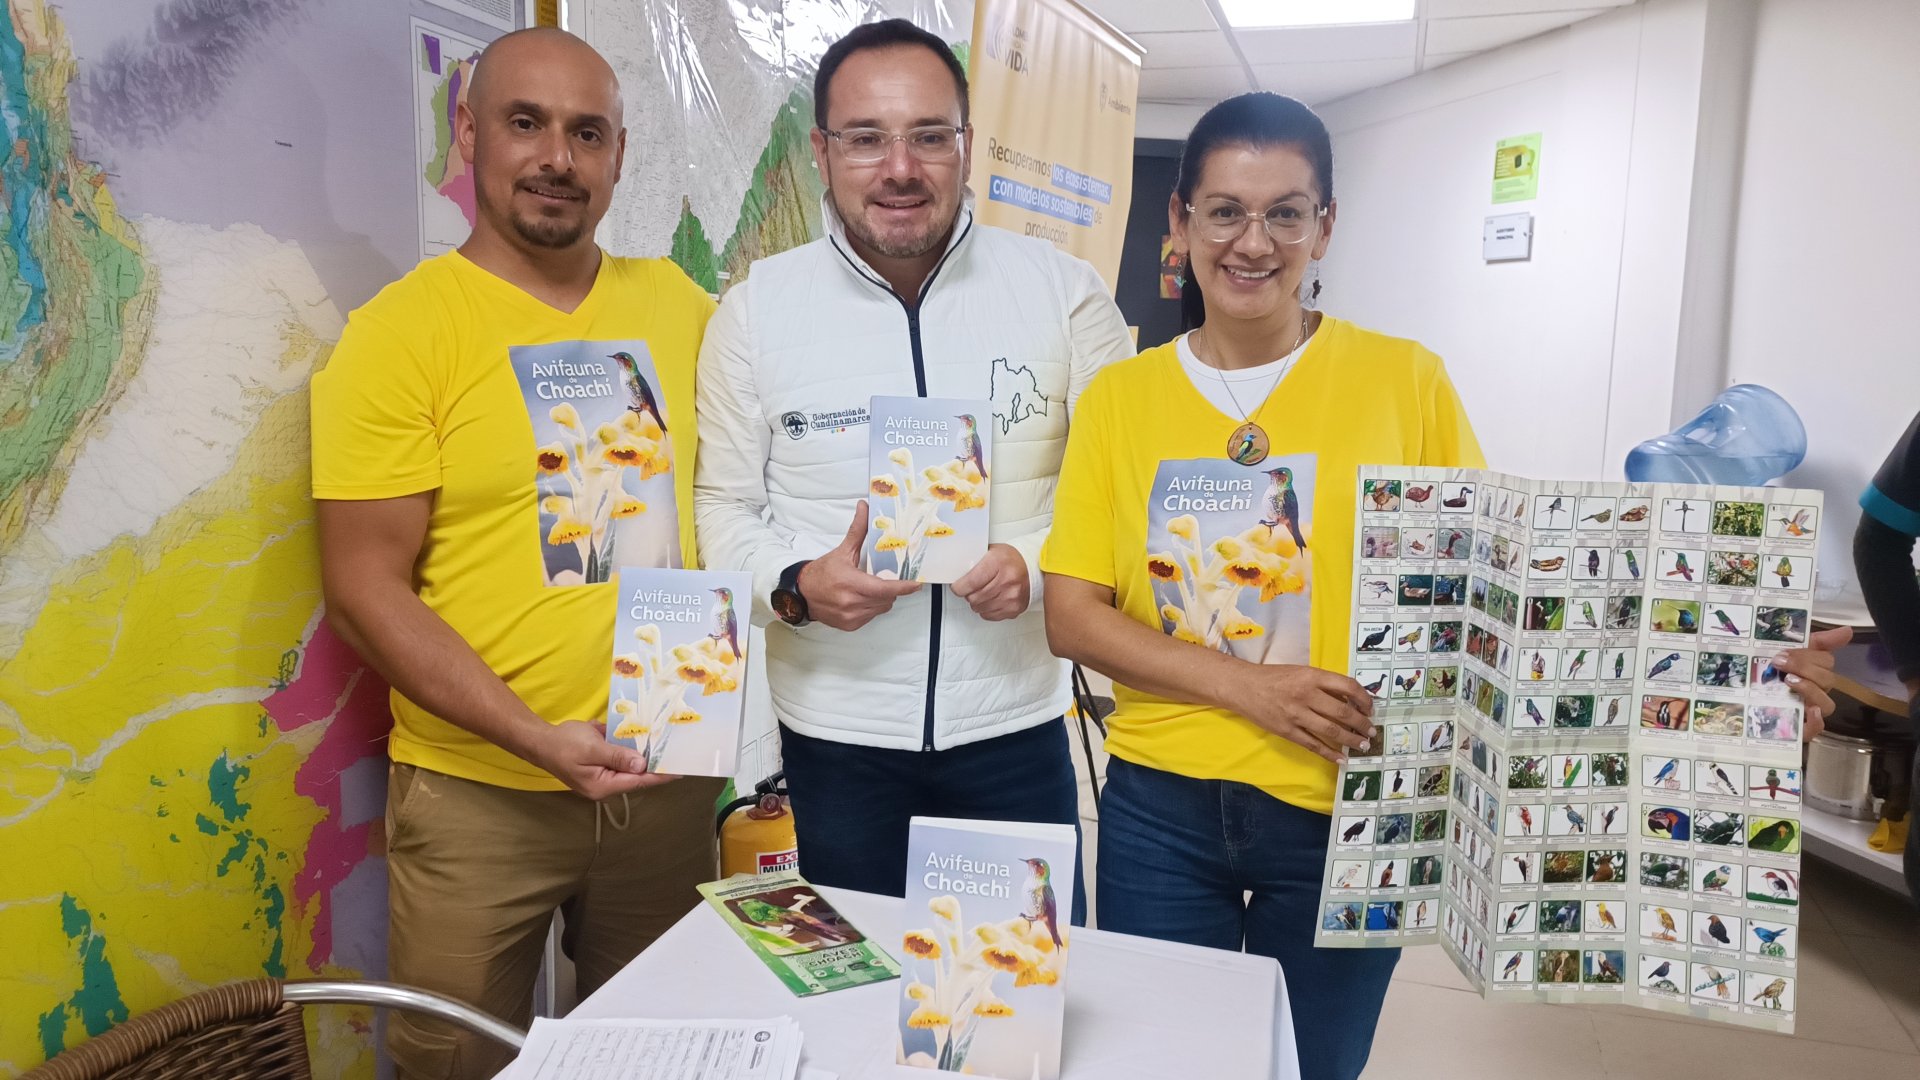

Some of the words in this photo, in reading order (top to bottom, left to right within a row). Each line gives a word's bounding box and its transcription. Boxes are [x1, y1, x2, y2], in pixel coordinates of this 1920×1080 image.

[1004, 48, 1029, 77] VIDA
[988, 137, 1051, 177] Recuperamos
[1053, 162, 1064, 182] los
[993, 179, 1013, 198] con
[1015, 184, 1050, 209] modelos
[532, 359, 606, 378] Avifauna
[536, 378, 613, 400] Choachí
[884, 415, 949, 432] Avifauna
[884, 431, 949, 447] Choachí
[1167, 475, 1253, 492] Avifauna
[1163, 494, 1253, 512] Choachí
[632, 588, 702, 606] Avifauna
[925, 852, 1010, 877] Avifauna
[963, 872, 973, 880] de
[923, 872, 1011, 899] Choachí
[822, 947, 857, 958] AVES
